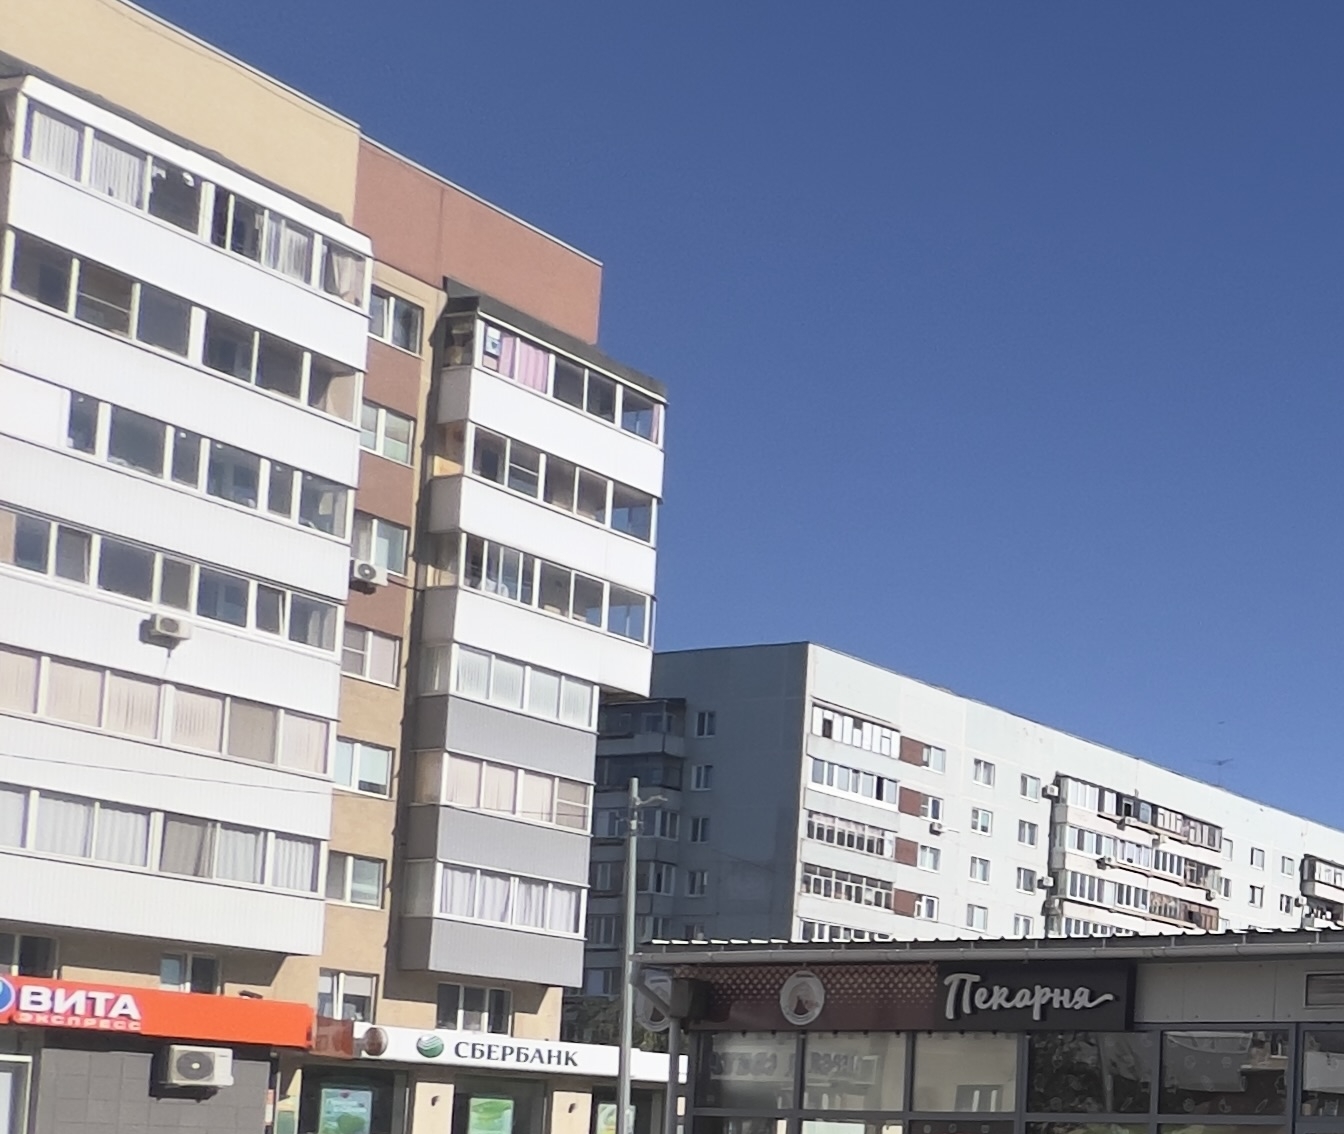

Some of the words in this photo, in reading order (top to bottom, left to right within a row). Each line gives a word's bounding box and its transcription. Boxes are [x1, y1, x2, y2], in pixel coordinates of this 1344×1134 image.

[19, 985, 142, 1020] ВИТА
[944, 973, 1114, 1021] Пекарня
[454, 1040, 579, 1067] СБЕРБАНК
